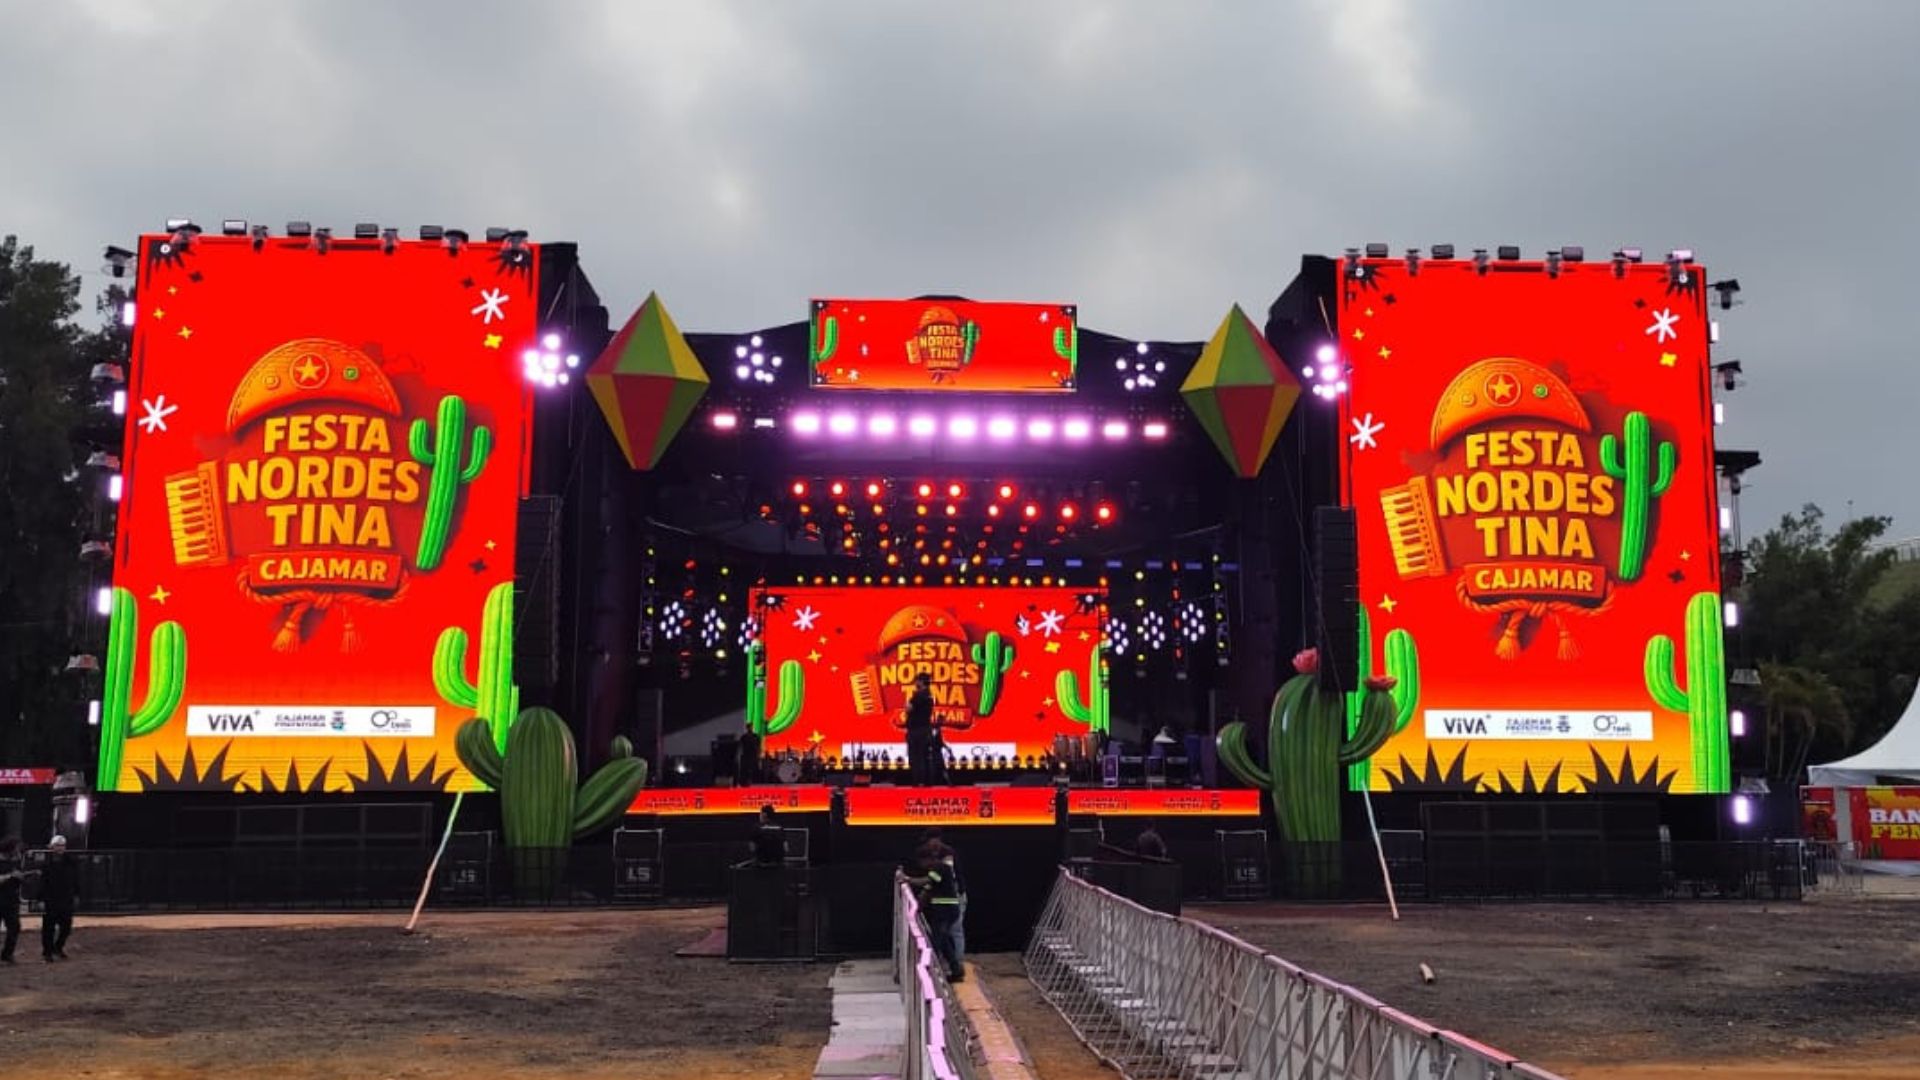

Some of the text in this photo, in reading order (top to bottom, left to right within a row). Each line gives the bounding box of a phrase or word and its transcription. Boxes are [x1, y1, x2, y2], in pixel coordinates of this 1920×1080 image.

[264, 414, 391, 453] FESTA
[1465, 431, 1584, 468] FESTA
[227, 456, 420, 503] NORDES
[1436, 470, 1615, 517] NORDES
[266, 504, 392, 547] TINA
[1475, 517, 1595, 558] TINA
[260, 558, 388, 582] CAJAMAR
[1475, 569, 1593, 591] CAJAMAR
[897, 641, 963, 660] FESTA
[901, 685, 966, 706] TNA
